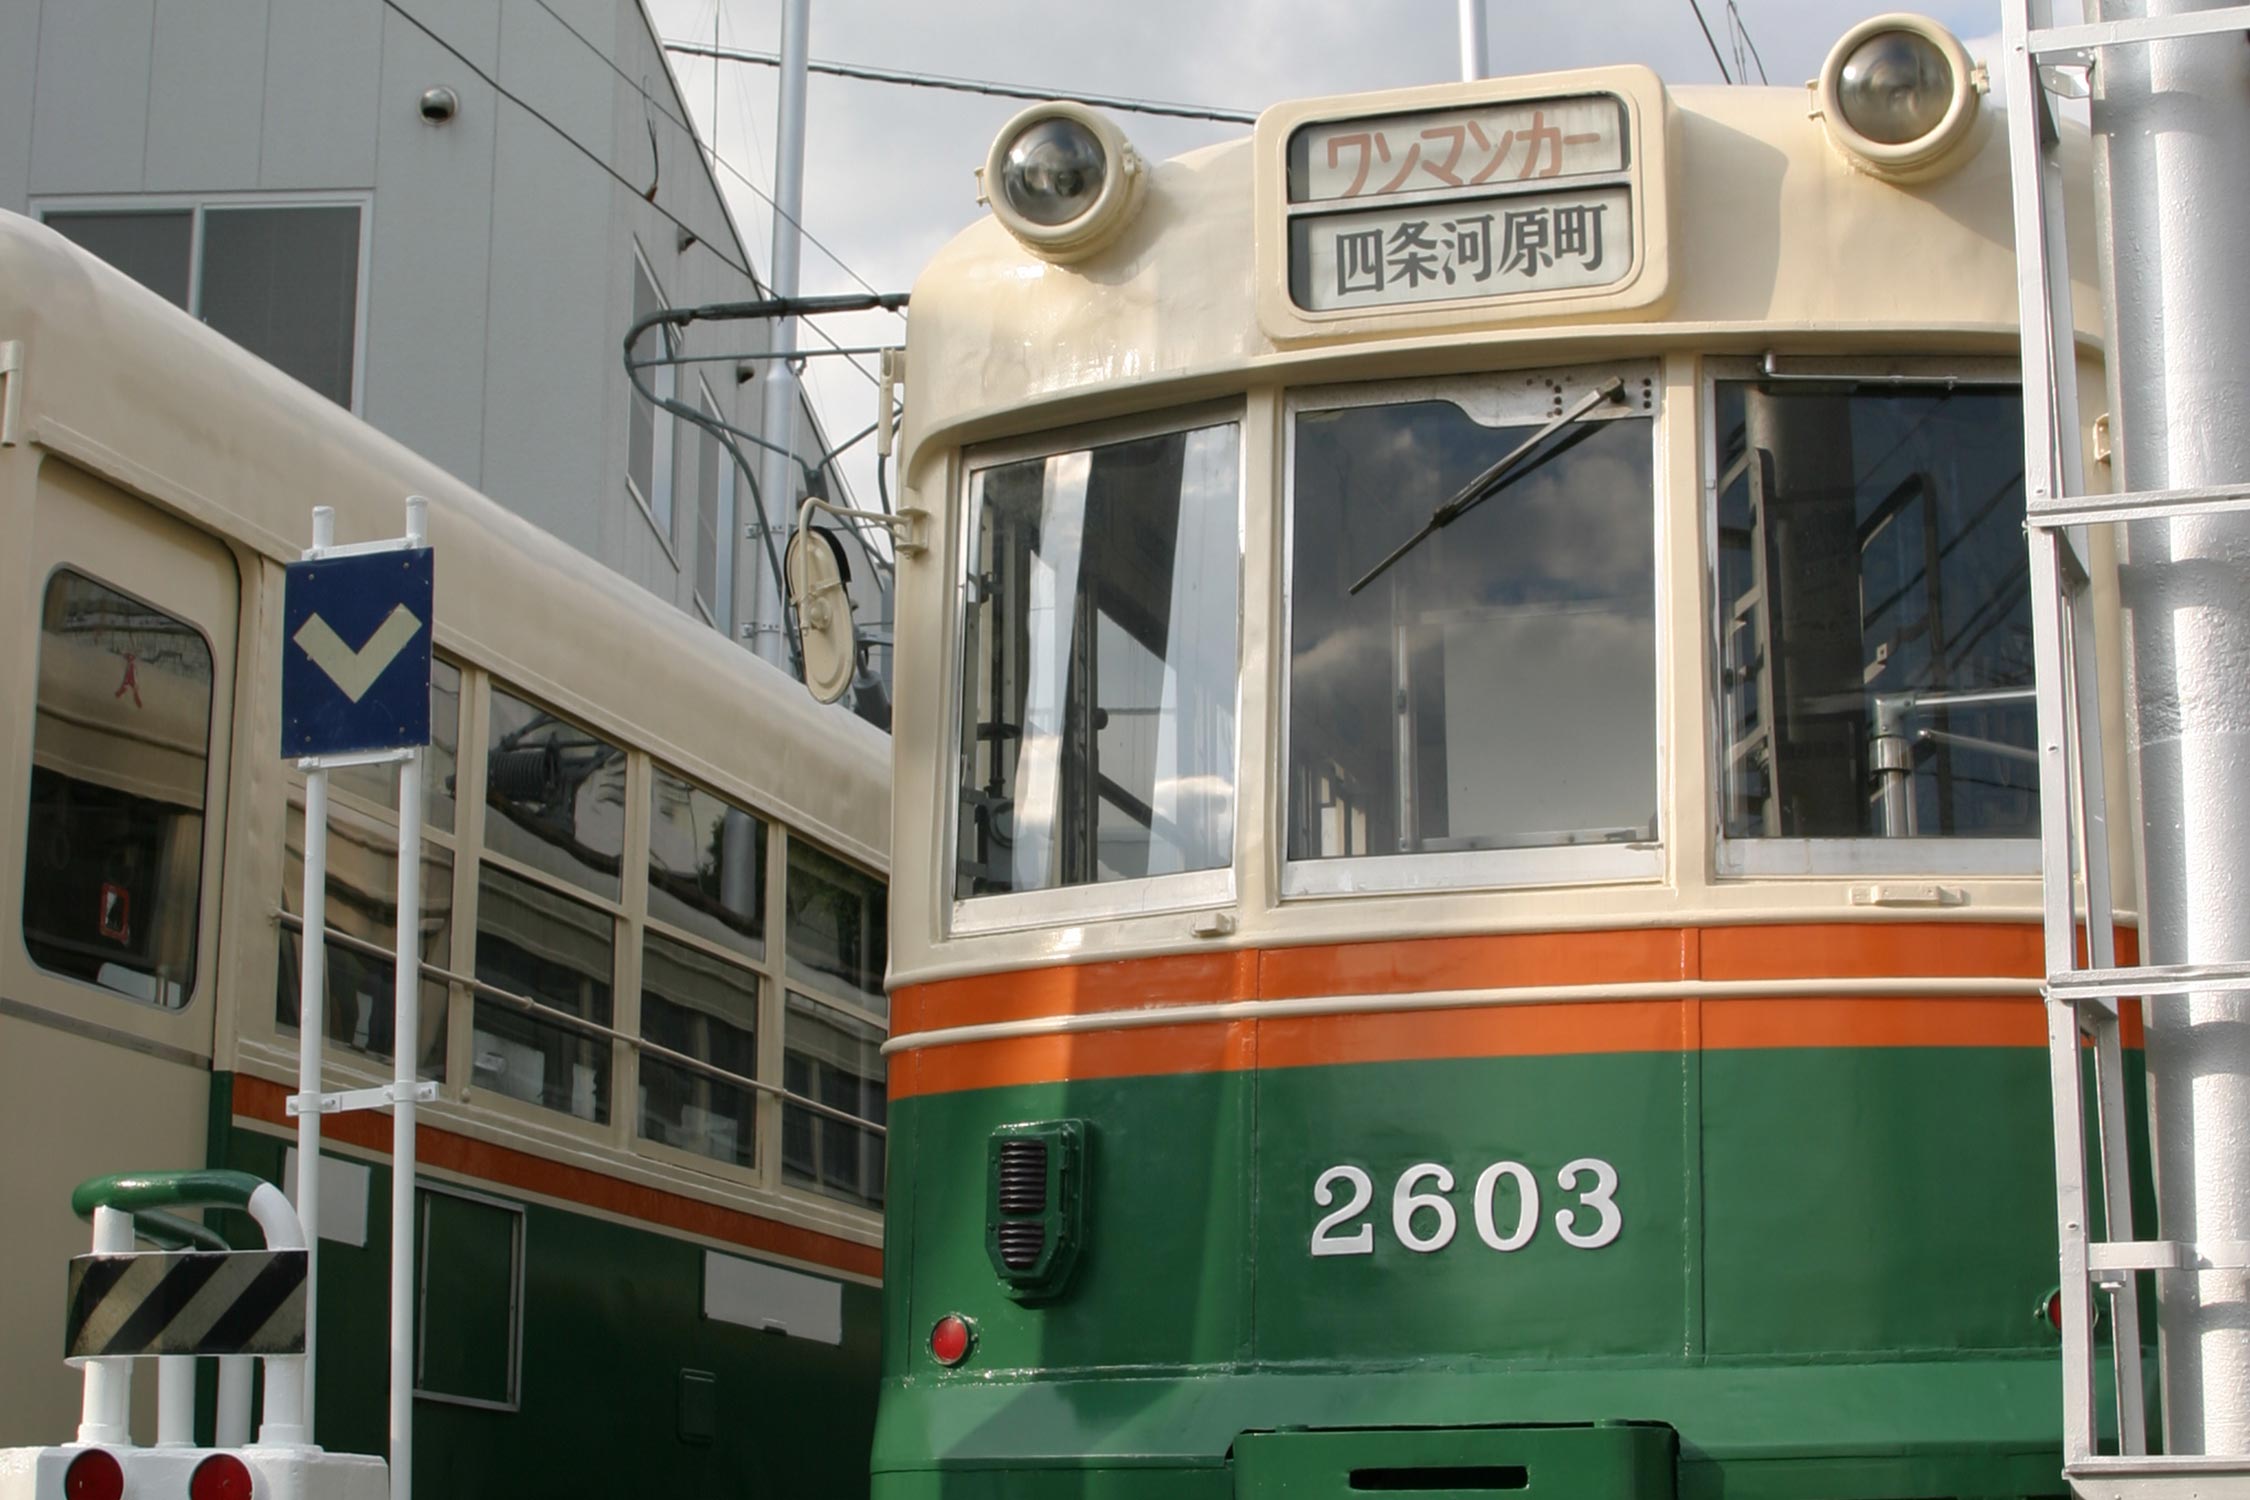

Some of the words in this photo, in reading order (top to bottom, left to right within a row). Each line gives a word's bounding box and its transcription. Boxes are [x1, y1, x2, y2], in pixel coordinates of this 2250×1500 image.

[1327, 111, 1601, 199] ワンマンカー
[1336, 204, 1608, 297] 四条河原町
[1311, 1158, 1622, 1256] 2603
